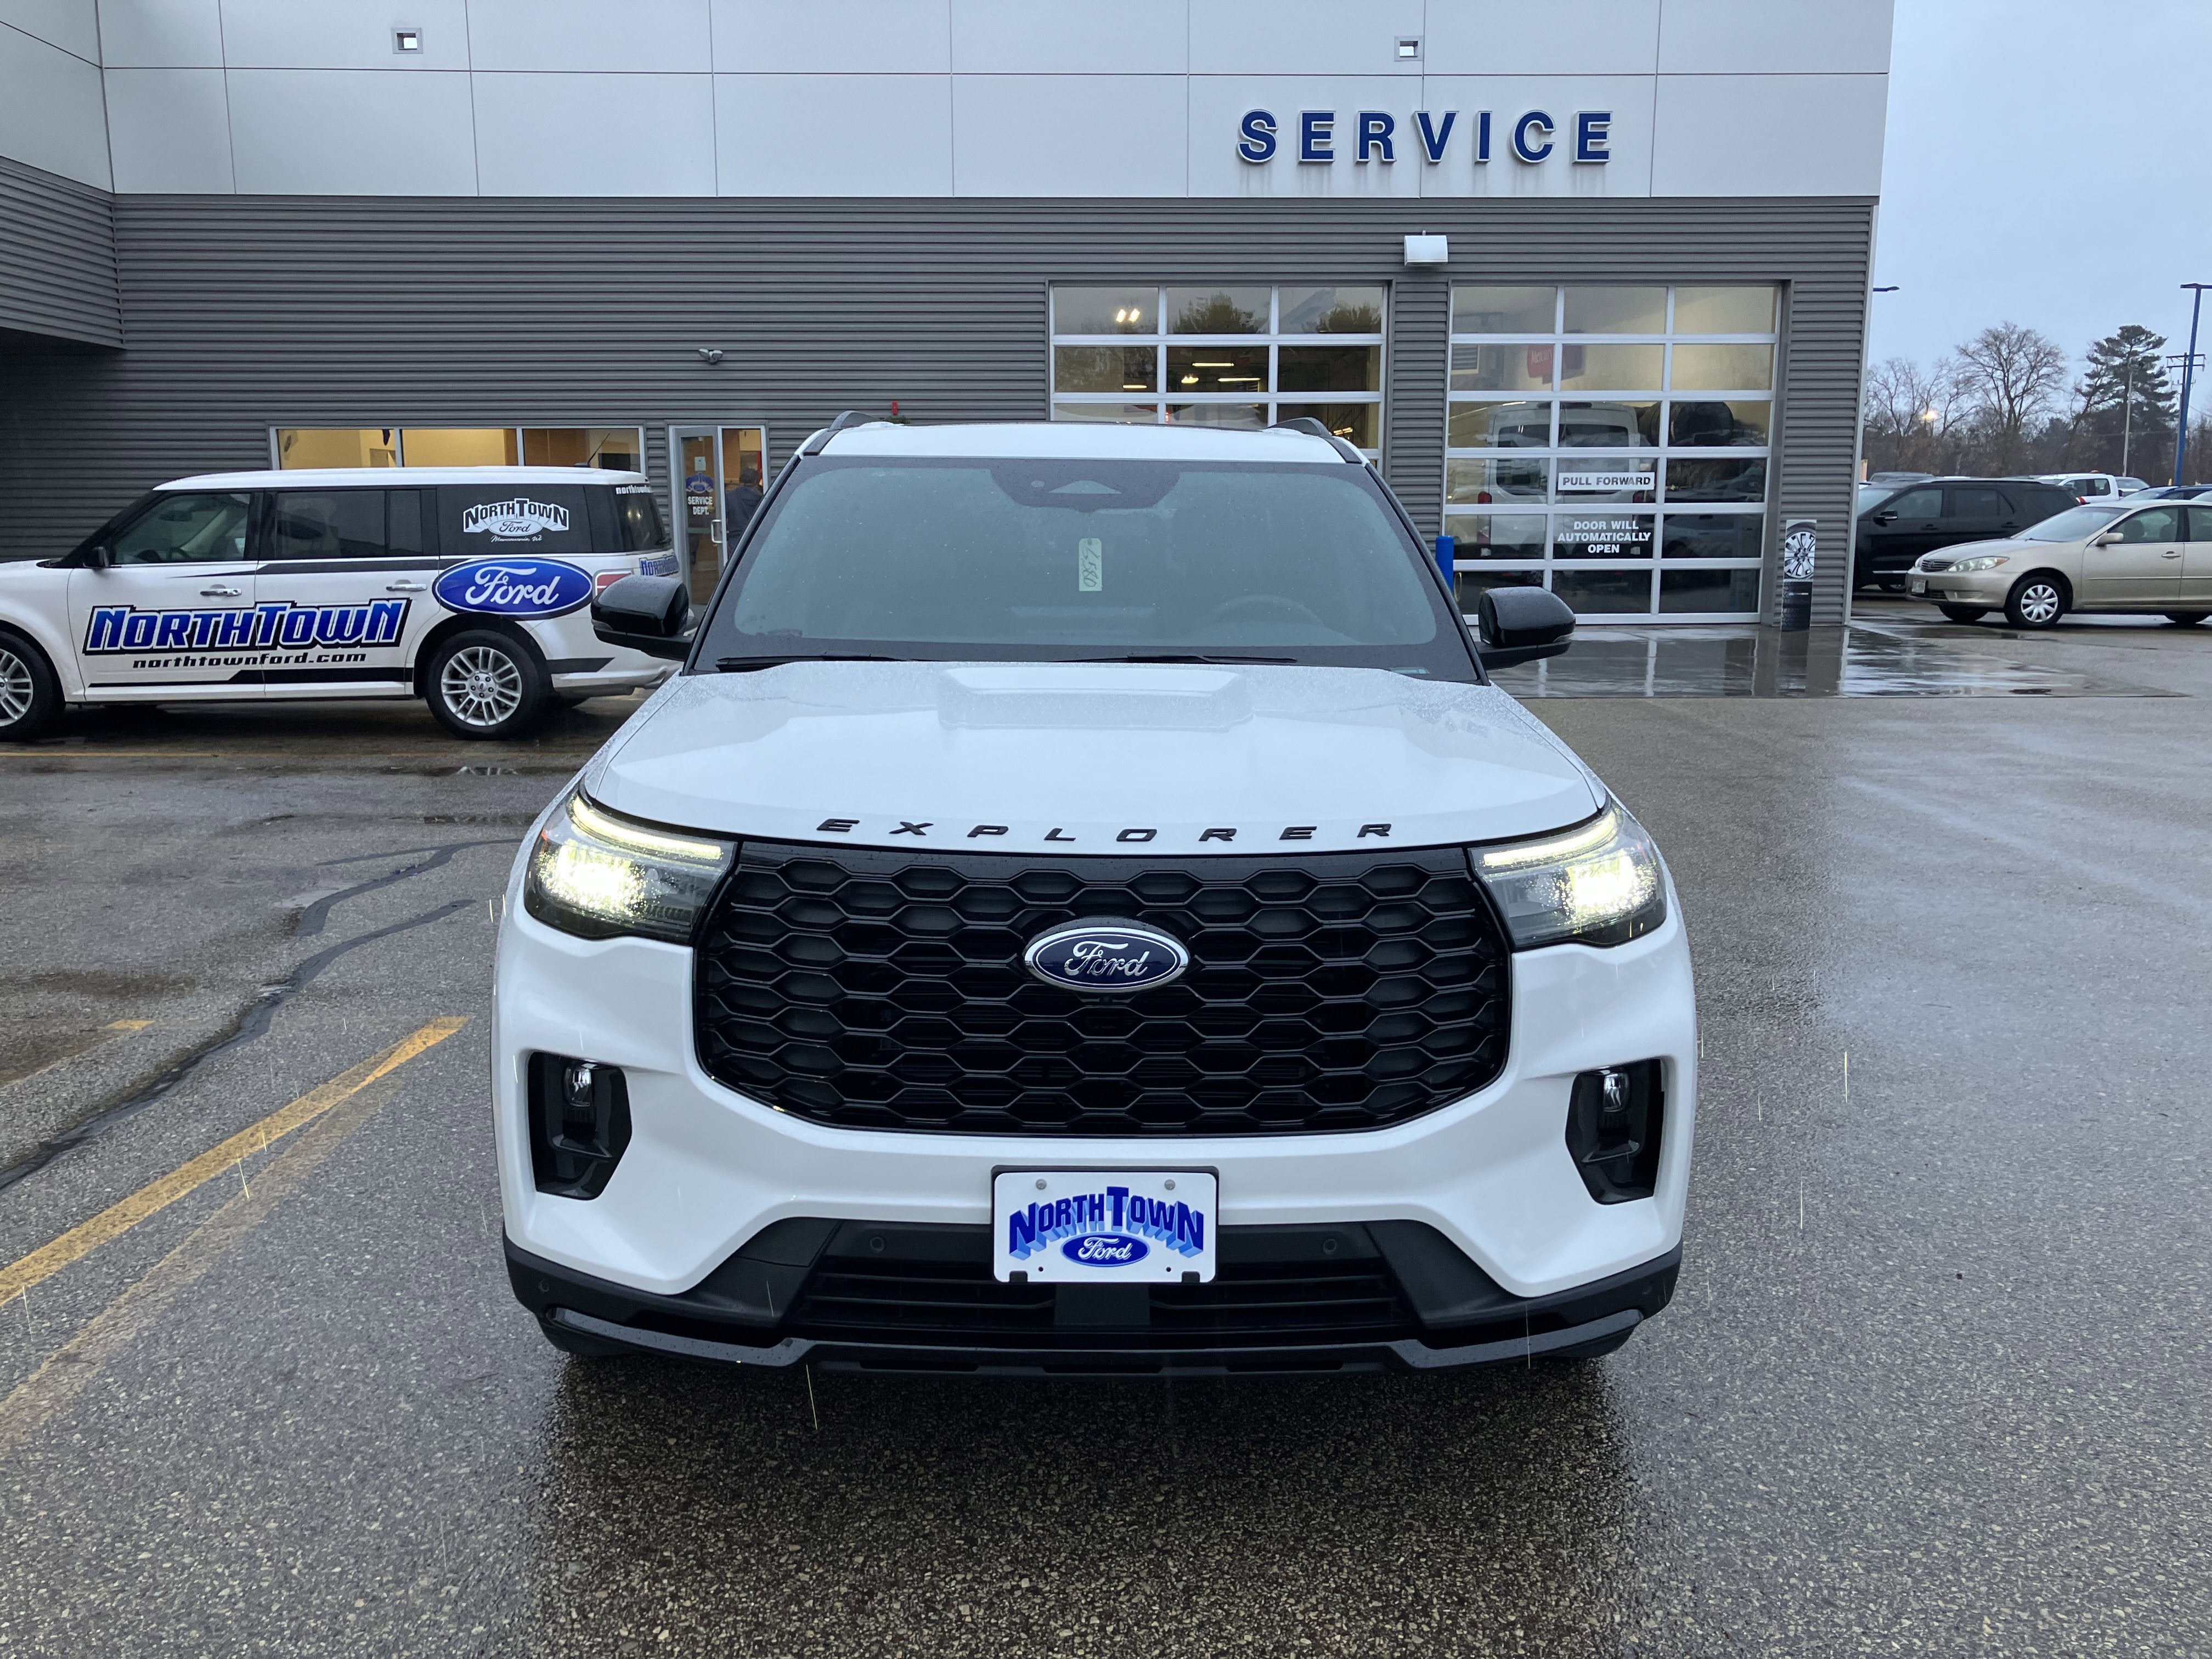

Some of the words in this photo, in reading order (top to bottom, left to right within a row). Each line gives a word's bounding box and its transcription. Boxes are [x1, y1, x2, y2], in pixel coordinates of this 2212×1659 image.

[1236, 109, 1613, 164] SERVICE
[1562, 477, 1592, 486] PULL
[1596, 477, 1651, 485] FORWARD
[687, 496, 713, 505] SERVICE
[692, 506, 709, 515] DEPT.
[499, 521, 532, 533] Ford
[1573, 521, 1607, 530] DOOR
[1611, 521, 1639, 529] WILL
[1557, 532, 1652, 541] AUTOMATICALLY
[1587, 544, 1620, 554] OPEN
[465, 566, 561, 605] Ford
[132, 652, 366, 669] northtownford.com
[816, 818, 1392, 842] EXPLORER
[1064, 940, 1150, 977] Ford
[1077, 1237, 1133, 1260] Ford
